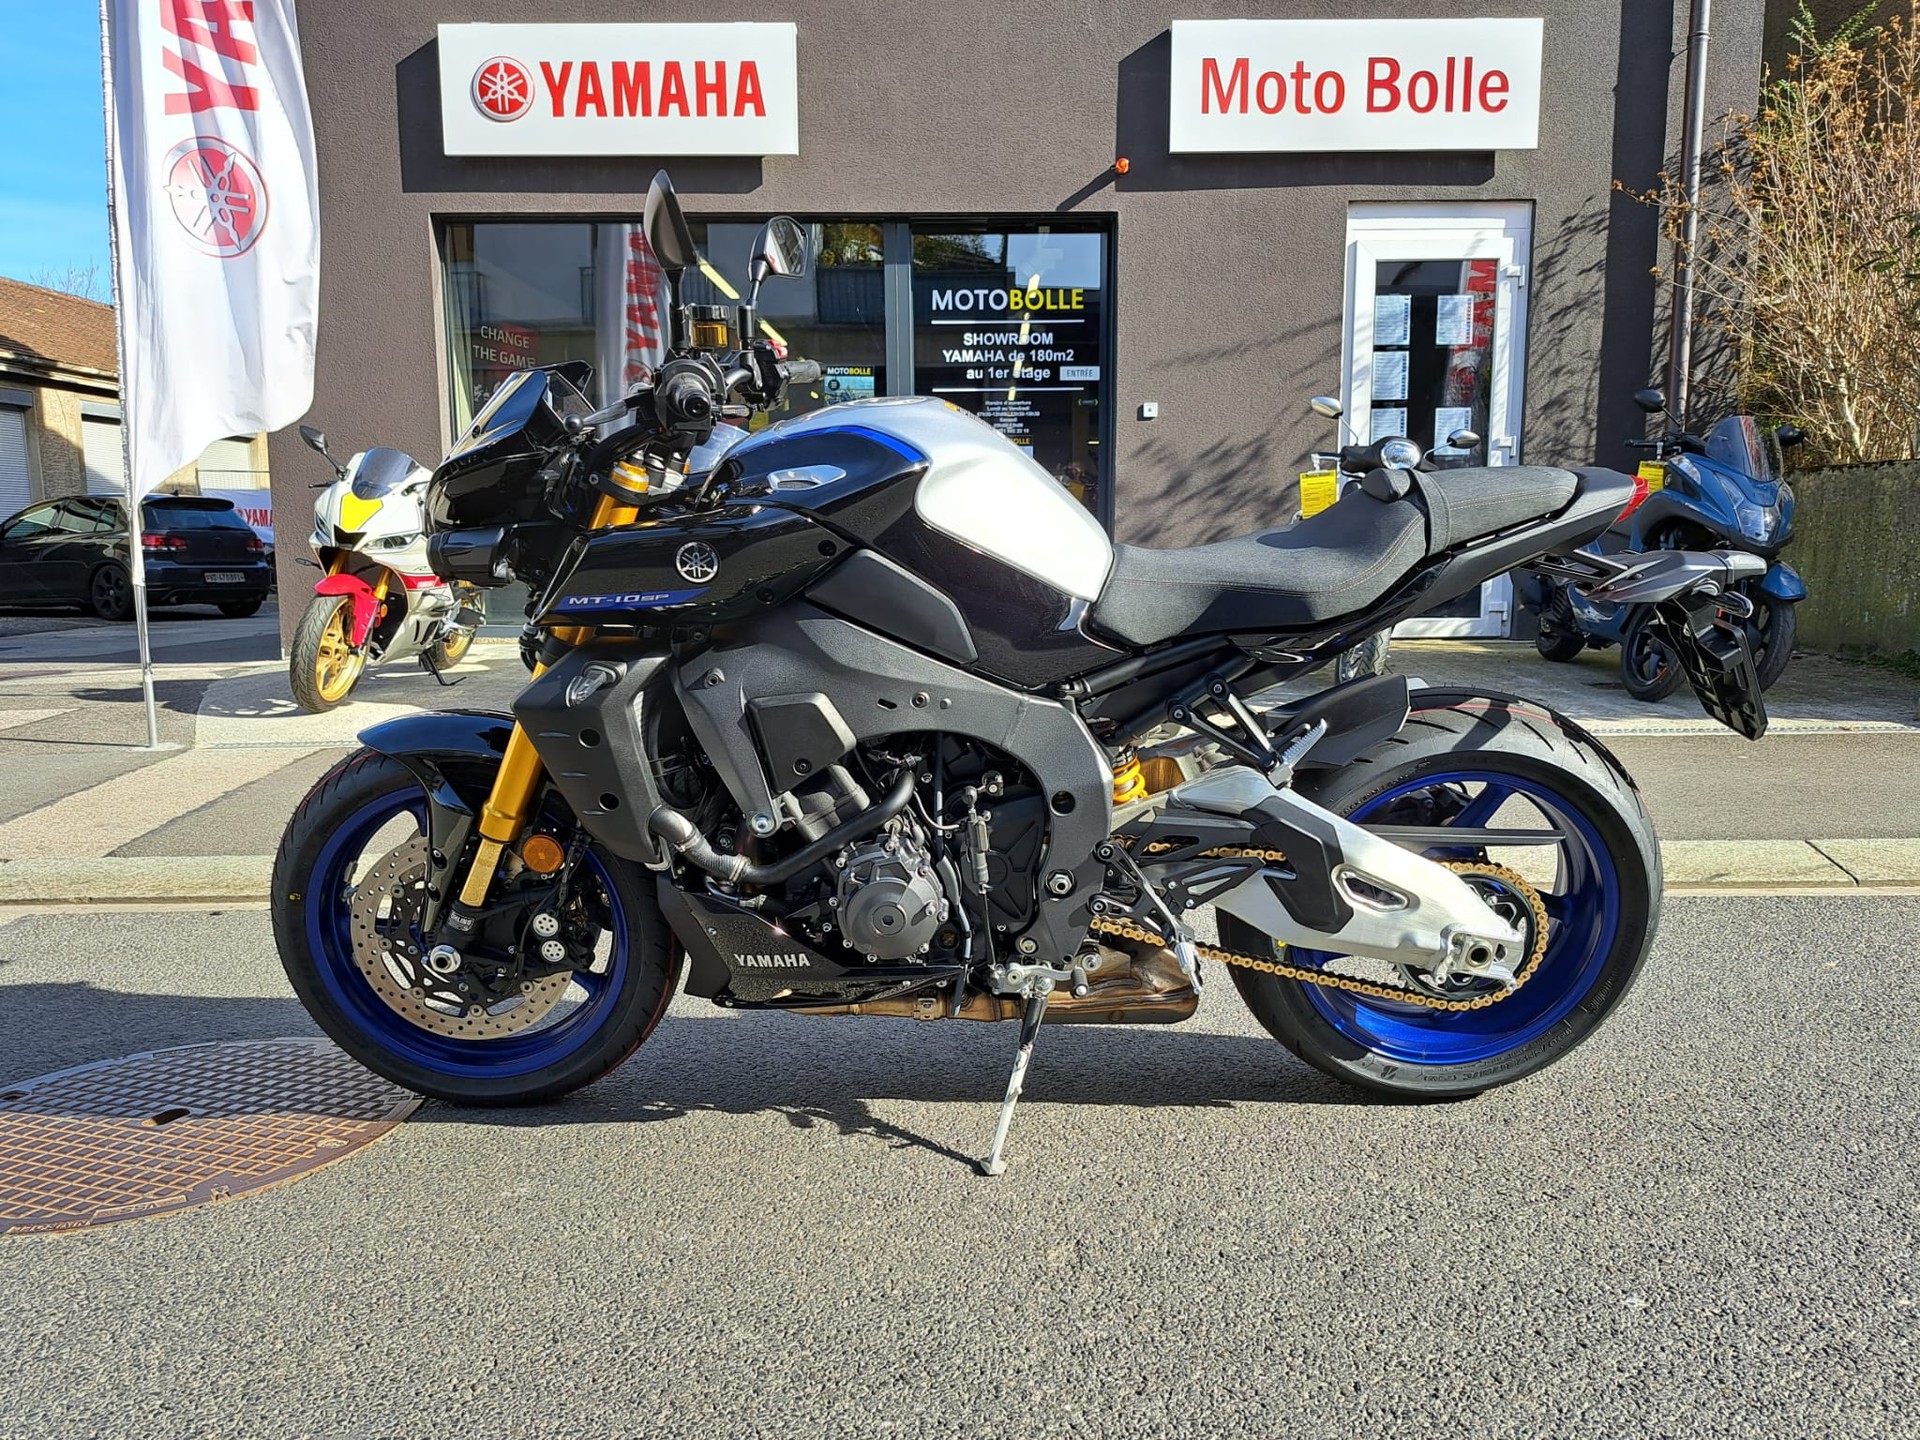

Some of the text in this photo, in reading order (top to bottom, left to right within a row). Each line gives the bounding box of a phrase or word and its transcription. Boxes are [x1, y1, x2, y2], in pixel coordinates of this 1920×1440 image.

[538, 60, 767, 118] YAMAHA
[1200, 56, 1510, 115] Moto Bolle
[931, 288, 1085, 311] MOTOBOLLE
[480, 325, 530, 349] CHANGE
[963, 332, 1054, 347] SHOWROOM
[472, 344, 497, 362] THE
[942, 349, 1075, 363] YAMAHA de 180m2
[827, 367, 872, 375] MOTOBOLLE
[966, 369, 983, 380] au
[987, 367, 1010, 380] 1er
[1066, 367, 1093, 378] ENTRÉE
[733, 952, 811, 968] YAMAHA
